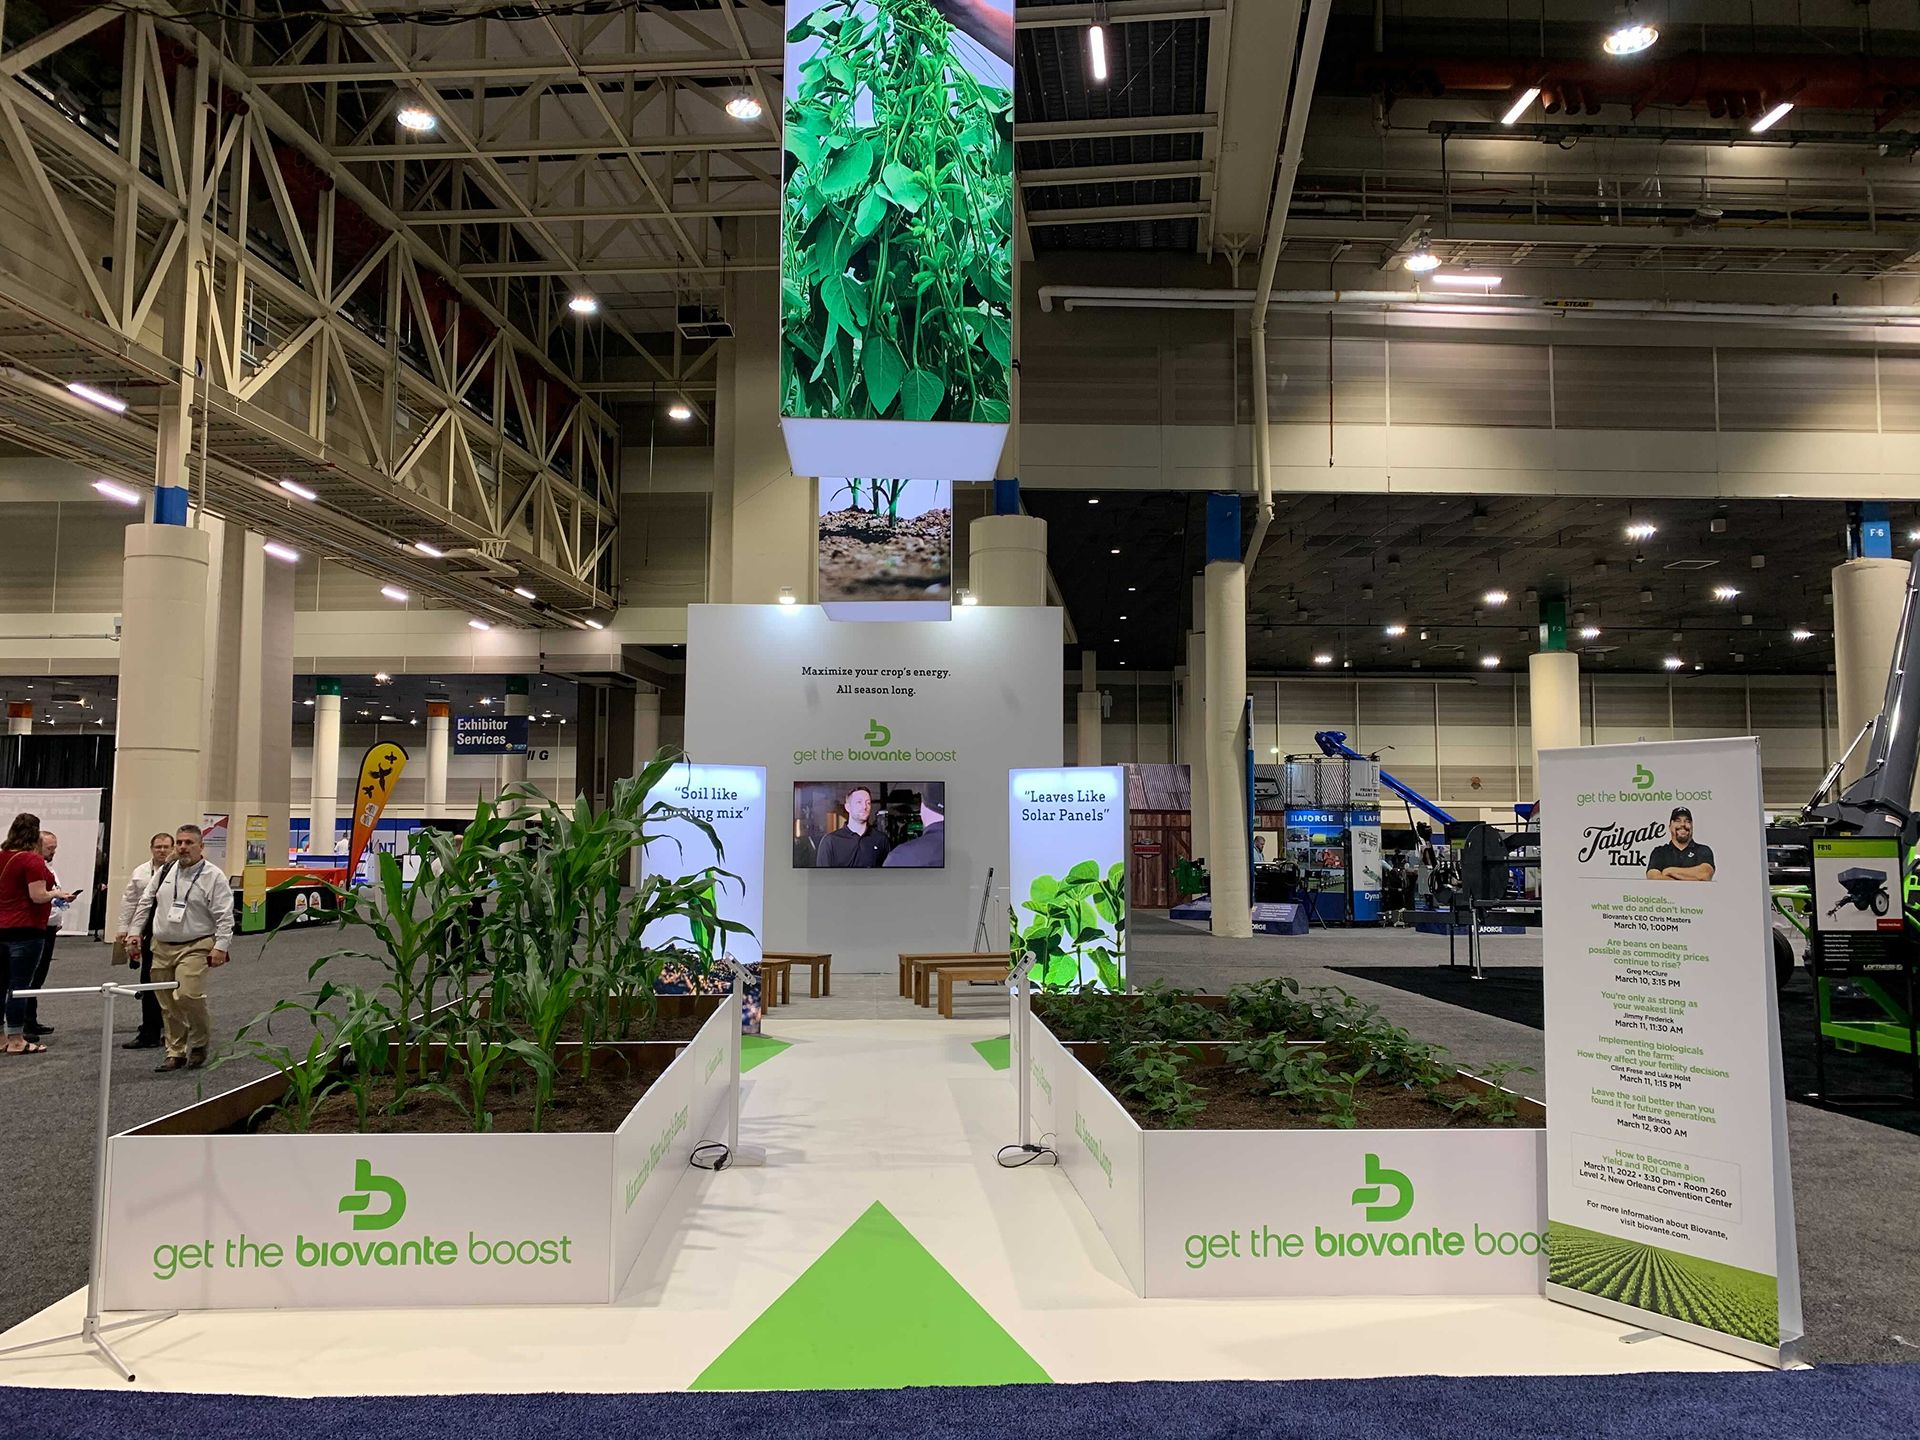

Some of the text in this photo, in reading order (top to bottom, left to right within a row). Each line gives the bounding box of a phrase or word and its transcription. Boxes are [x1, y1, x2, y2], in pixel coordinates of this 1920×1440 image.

[802, 666, 951, 679] Maximize your crop's energy.
[836, 685, 916, 697] All season long.
[457, 719, 508, 731] Exhibitor
[457, 733, 506, 745] Services
[793, 748, 957, 765] get the biovante boost
[712, 788, 738, 800] like
[1077, 790, 1106, 802] Like
[1577, 789, 1713, 806] get the biovante boost
[1022, 808, 1056, 821] Solar
[1578, 821, 1666, 863] Tailgate
[1608, 850, 1647, 867] Talk
[1626, 904, 1637, 912] do
[1638, 905, 1653, 913] and
[1655, 905, 1677, 914] don't
[1680, 906, 1704, 915] know
[1602, 913, 1633, 921] Biovante's
[1666, 916, 1691, 924] Masters
[1614, 922, 1679, 932] March 10, 1:00PM
[1607, 939, 1621, 947] Are
[1623, 939, 1647, 948] beans
[1662, 942, 1688, 951] beans
[1588, 947, 1620, 955] possible
[1634, 949, 1681, 961] commodity
[1683, 953, 1710, 962] prices
[1614, 957, 1681, 969] continue to rise?
[1626, 968, 1668, 977] Greg McClure
[1615, 975, 1638, 984] March
[1640, 977, 1650, 986] 10,
[1652, 978, 1666, 986] 3:15
[1601, 991, 1626, 1000] You're
[1628, 994, 1645, 1003] only
[1658, 998, 1686, 1008] strong
[1688, 1000, 1698, 1008] as
[1613, 1002, 1685, 1015] your weakest link
[1623, 1013, 1674, 1024] Jimmy Frederick
[1615, 1020, 1683, 1034] March 11, 11:30 AM
[1599, 1035, 1704, 1055] Implementing biologicals
[1637, 1049, 1651, 1058] the
[1652, 1050, 1674, 1061] farm:
[1577, 1049, 1729, 1078] How they affect your fertility decisions
[1611, 1064, 1625, 1073] Clint
[1644, 1069, 1656, 1077] and
[1658, 1071, 1672, 1080] Luke
[1620, 1074, 1682, 1090] March 11, 1:15 PM
[1591, 1087, 1715, 1114] Leave the soil better than you
[1591, 1096, 1716, 1124] found it for future generations
[1632, 1113, 1646, 1121] Matt
[1617, 1119, 1687, 1137] March 12, 9:00 AM
[1616, 1149, 1634, 1159] How
[1636, 1153, 1645, 1162] to
[1647, 1155, 1682, 1170] Become
[1602, 1155, 1705, 1183] Yield and ROI Champion
[1584, 1161, 1727, 1197] March 11, 2022 3:30 pm Room 260
[1579, 1169, 1733, 1208] Level 2, New Orleans Convention Center
[1587, 1200, 1599, 1208] For
[1601, 1204, 1619, 1214] more
[1666, 1219, 1689, 1230] about
[1690, 1224, 1728, 1240] Biovante,
[1620, 1217, 1635, 1227] visit
[1184, 1223, 1550, 1269] get the biovante boos
[153, 1232, 572, 1280] get the biovante boost
